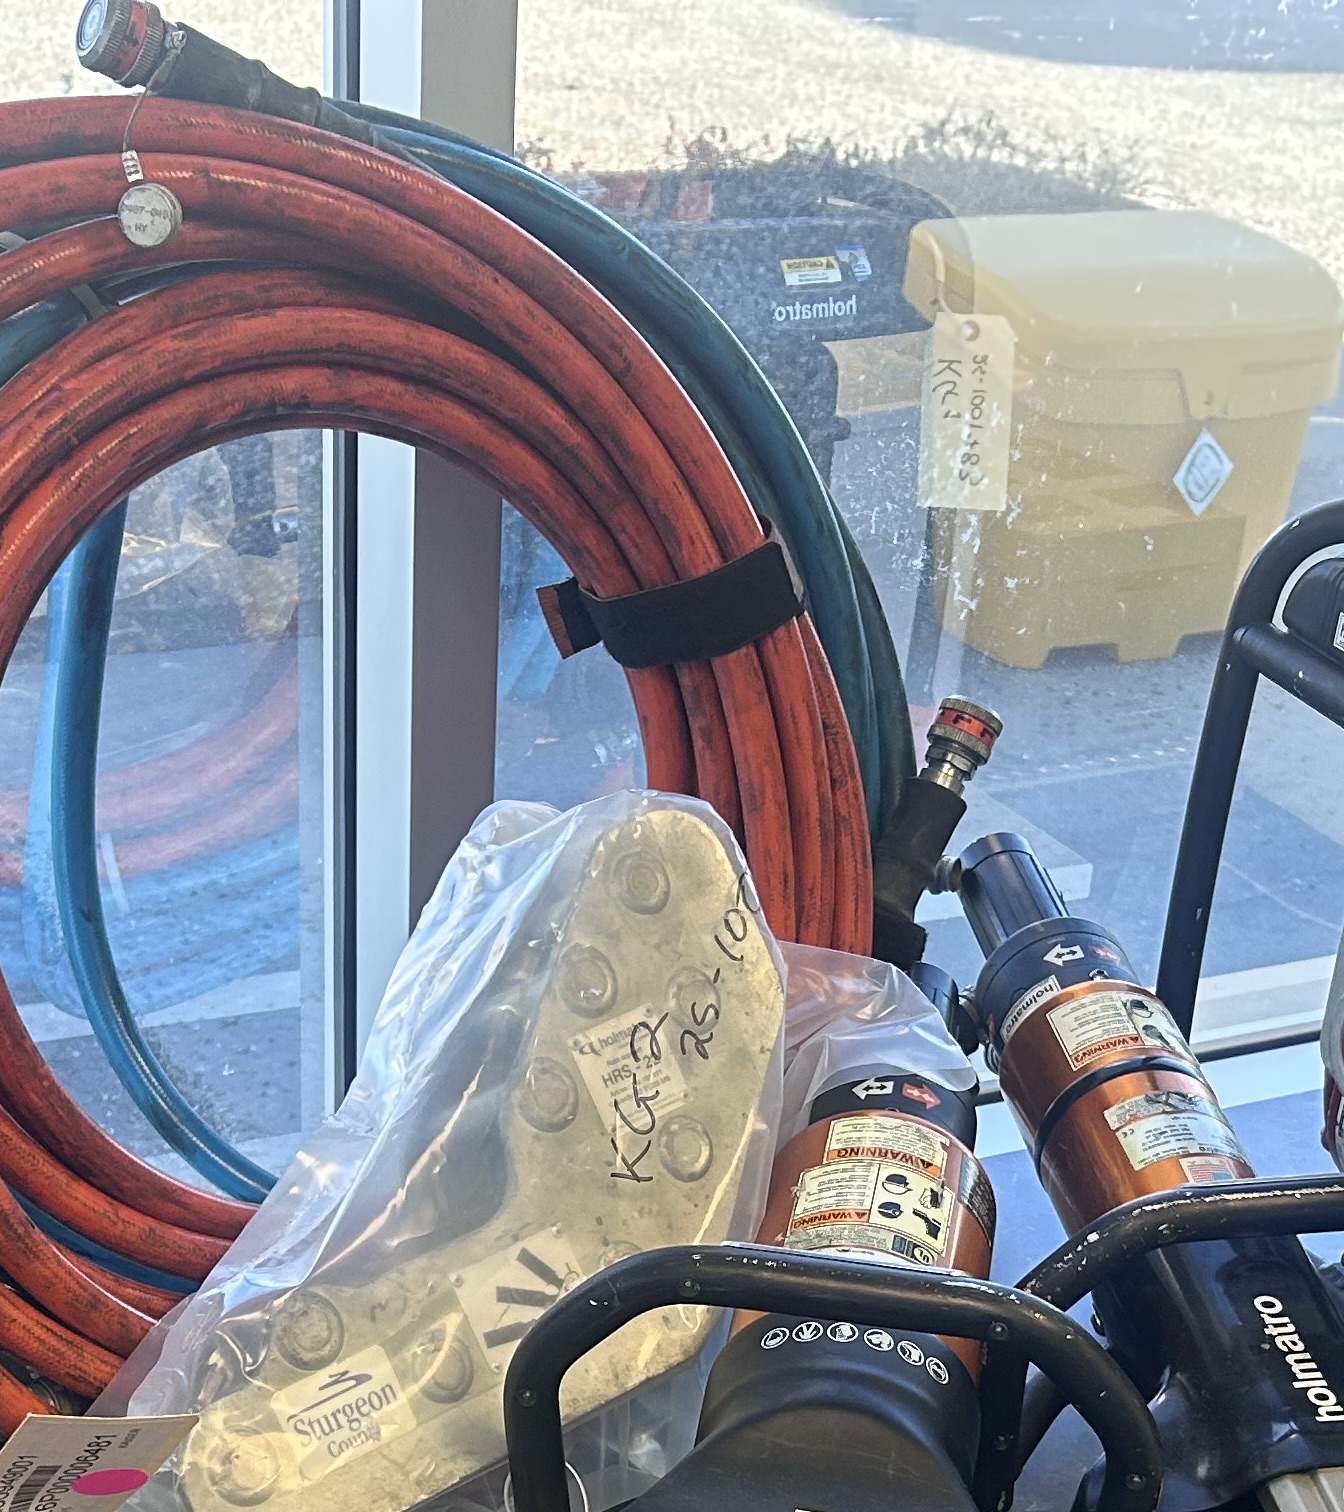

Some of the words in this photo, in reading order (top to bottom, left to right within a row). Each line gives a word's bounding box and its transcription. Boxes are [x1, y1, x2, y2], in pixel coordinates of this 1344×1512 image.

[1006, 983, 1054, 1033] holmatro
[601, 1066, 632, 1089] HRS
[837, 1147, 919, 1168] WARNING
[793, 1210, 853, 1228] WARNING
[293, 1383, 397, 1447] Sturgeon
[327, 1419, 381, 1458] Coun
